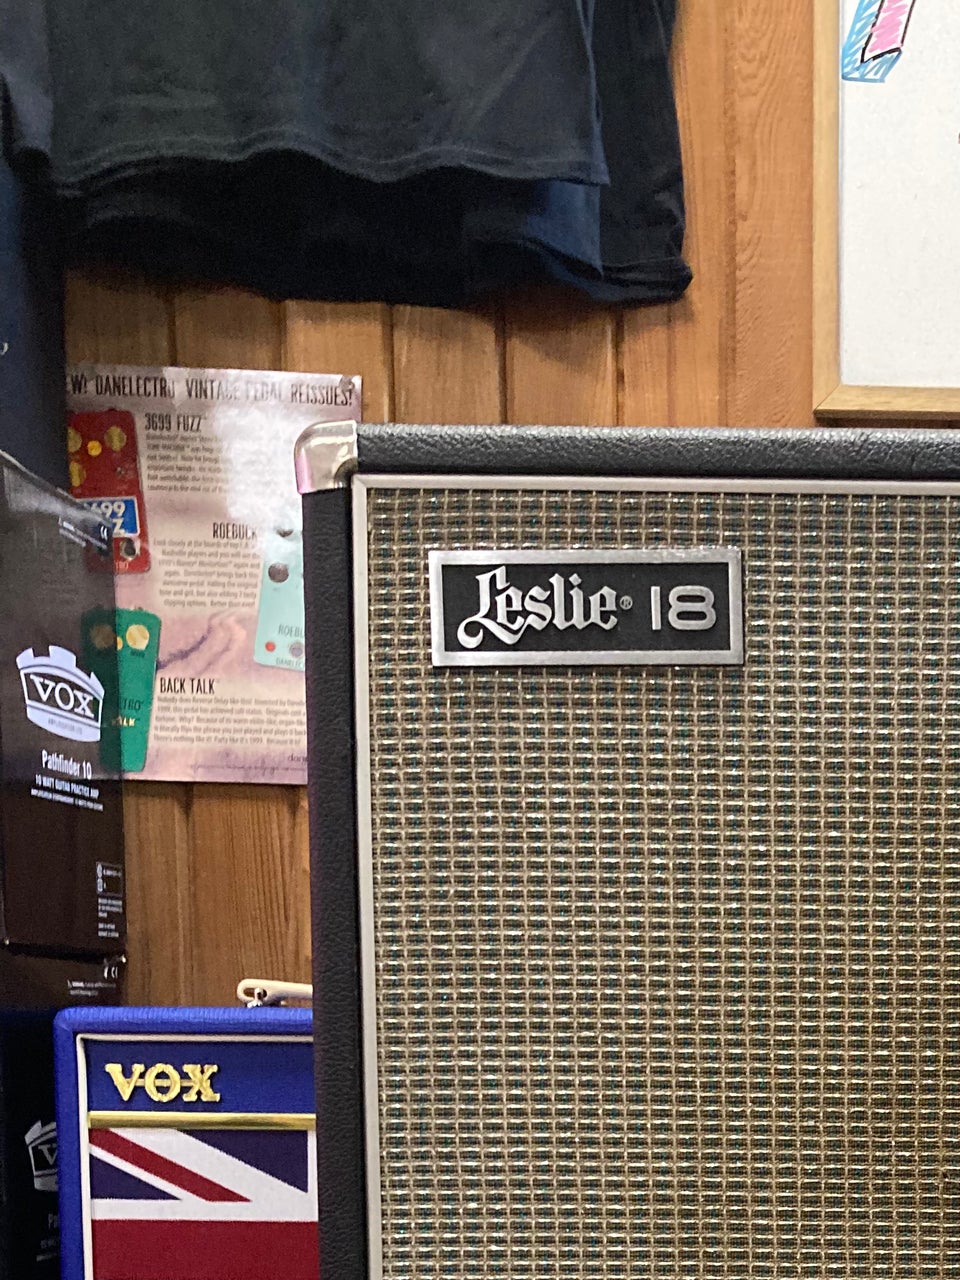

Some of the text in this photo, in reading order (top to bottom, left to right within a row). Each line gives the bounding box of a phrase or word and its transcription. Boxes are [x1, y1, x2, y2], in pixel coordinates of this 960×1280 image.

[144, 413, 171, 431] 3699
[651, 585, 717, 631] 18
[30, 674, 95, 718] VOX
[160, 677, 215, 695] BACK TALK
[42, 749, 92, 780] Pathfinder 10
[105, 1063, 221, 1103] VOX
